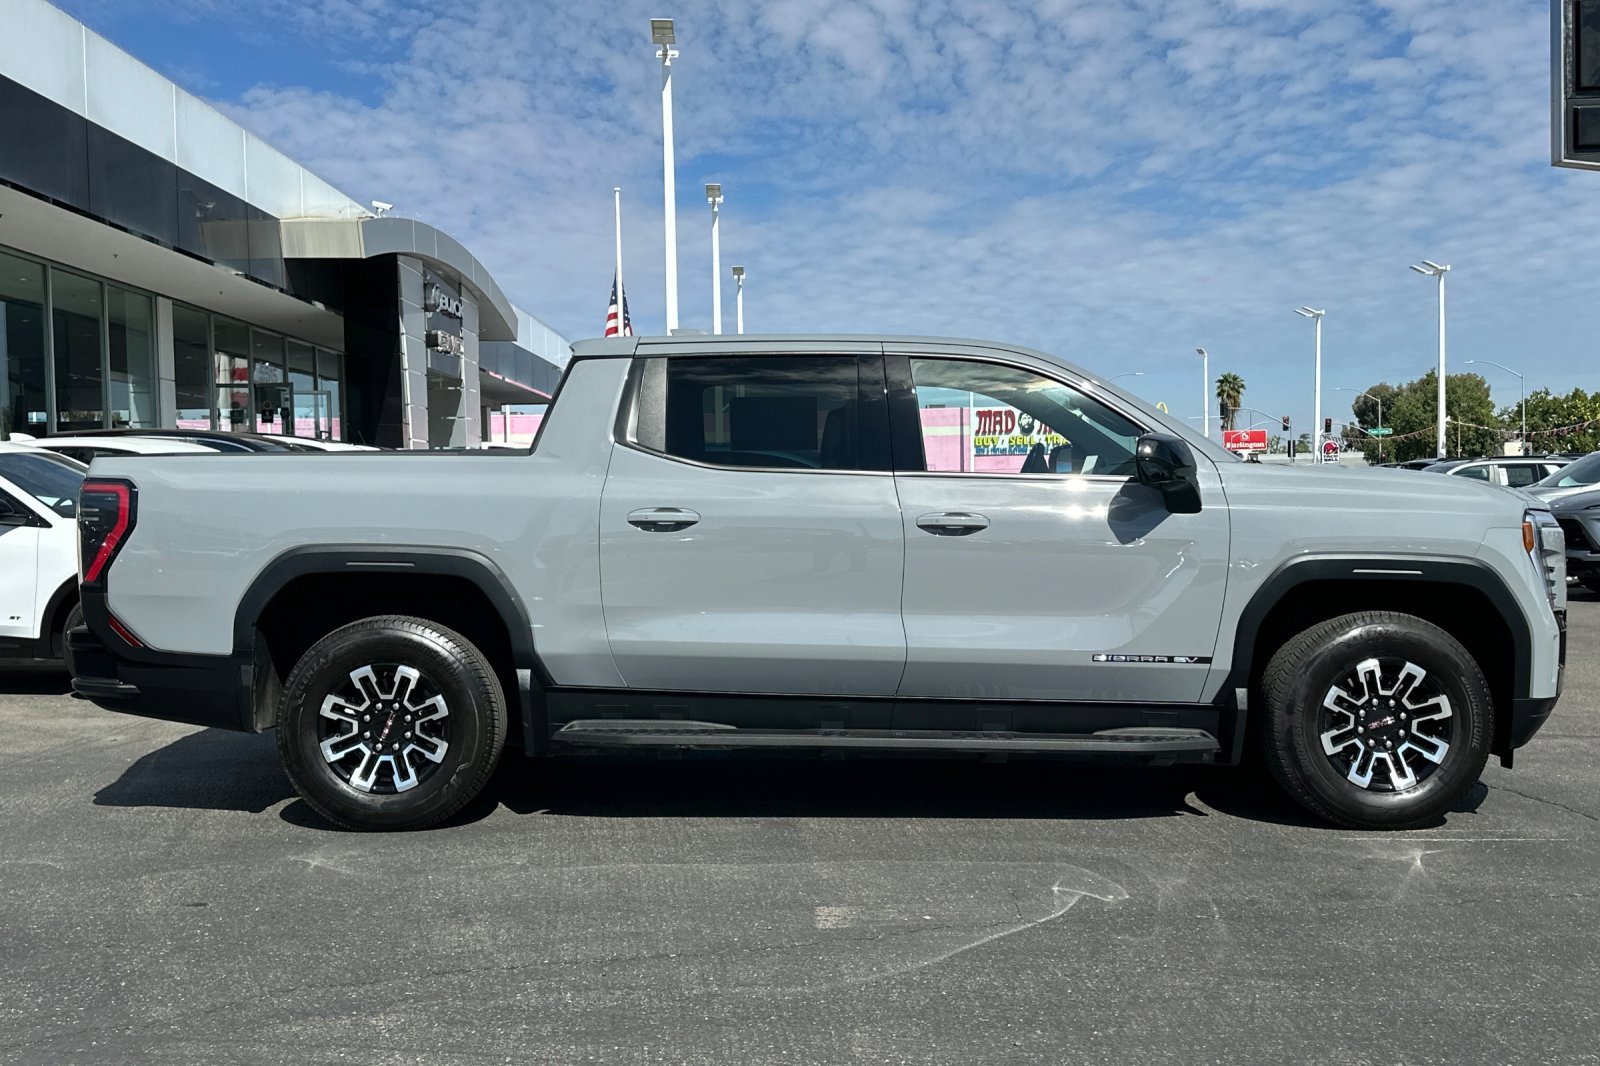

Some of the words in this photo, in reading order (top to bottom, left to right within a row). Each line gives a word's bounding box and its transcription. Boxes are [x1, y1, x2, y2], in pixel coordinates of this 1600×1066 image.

[975, 410, 1015, 436] MAD
[974, 436, 999, 446] BUY
[1008, 436, 1036, 446] SELL
